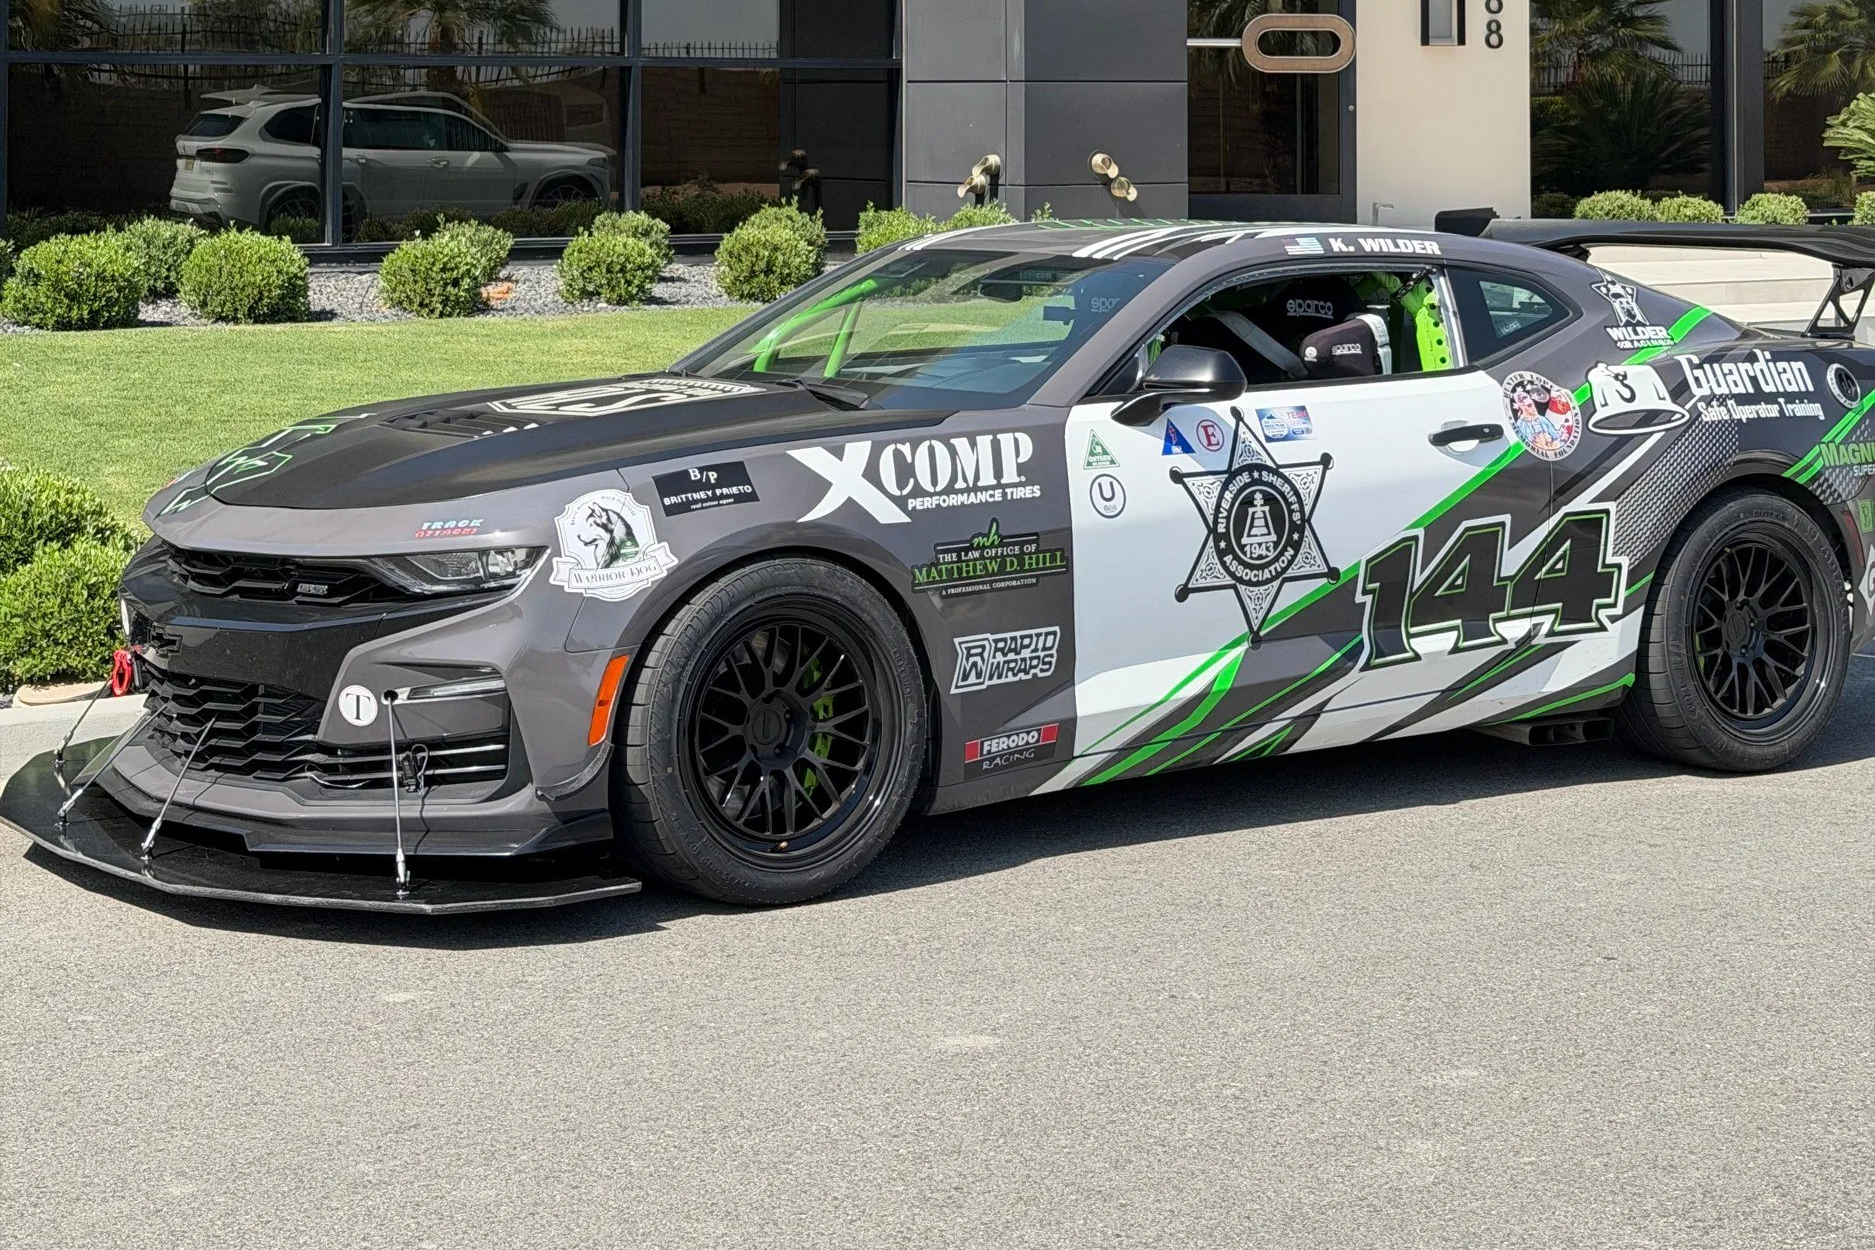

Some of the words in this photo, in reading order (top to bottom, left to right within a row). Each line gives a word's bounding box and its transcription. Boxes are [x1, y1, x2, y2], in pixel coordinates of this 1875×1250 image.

[1328, 238, 1355, 252] K.
[1358, 238, 1441, 255] WILDER
[1286, 299, 1333, 318] sparco
[1606, 326, 1671, 341] WILDER
[1673, 349, 1815, 397] Guardian
[1697, 401, 1730, 421] Safe
[1727, 399, 1781, 423] Operator
[1777, 398, 1825, 420] Training
[1201, 424, 1220, 447] E
[663, 490, 712, 506] BRITTNEY
[716, 485, 753, 497] PRIETO
[907, 490, 1003, 511] PERFORMANCE
[1005, 485, 1041, 501] TIRES
[1098, 481, 1116, 503] U
[1217, 471, 1252, 533] RIVERSIDE
[938, 553, 957, 563] THE
[961, 550, 981, 559] LAW
[984, 546, 1021, 558] OFFICE
[1023, 543, 1037, 553] OF
[1244, 542, 1275, 558] 1943
[573, 569, 626, 585] WARRIOR
[630, 563, 658, 579] DOG
[913, 558, 1001, 583] MATTHEW
[1006, 556, 1020, 572] D.
[1023, 551, 1066, 570] HILL
[1223, 546, 1295, 582] ASSOCIATION
[947, 582, 991, 595] PROFESSIONAL
[992, 577, 1037, 589] CORPORATION
[1360, 507, 1622, 668] 144
[991, 630, 1058, 659] RAPID
[988, 652, 1055, 681] WRAPS
[346, 692, 372, 722] T
[983, 730, 1039, 755] FERODO
[982, 749, 1035, 771] RACING
